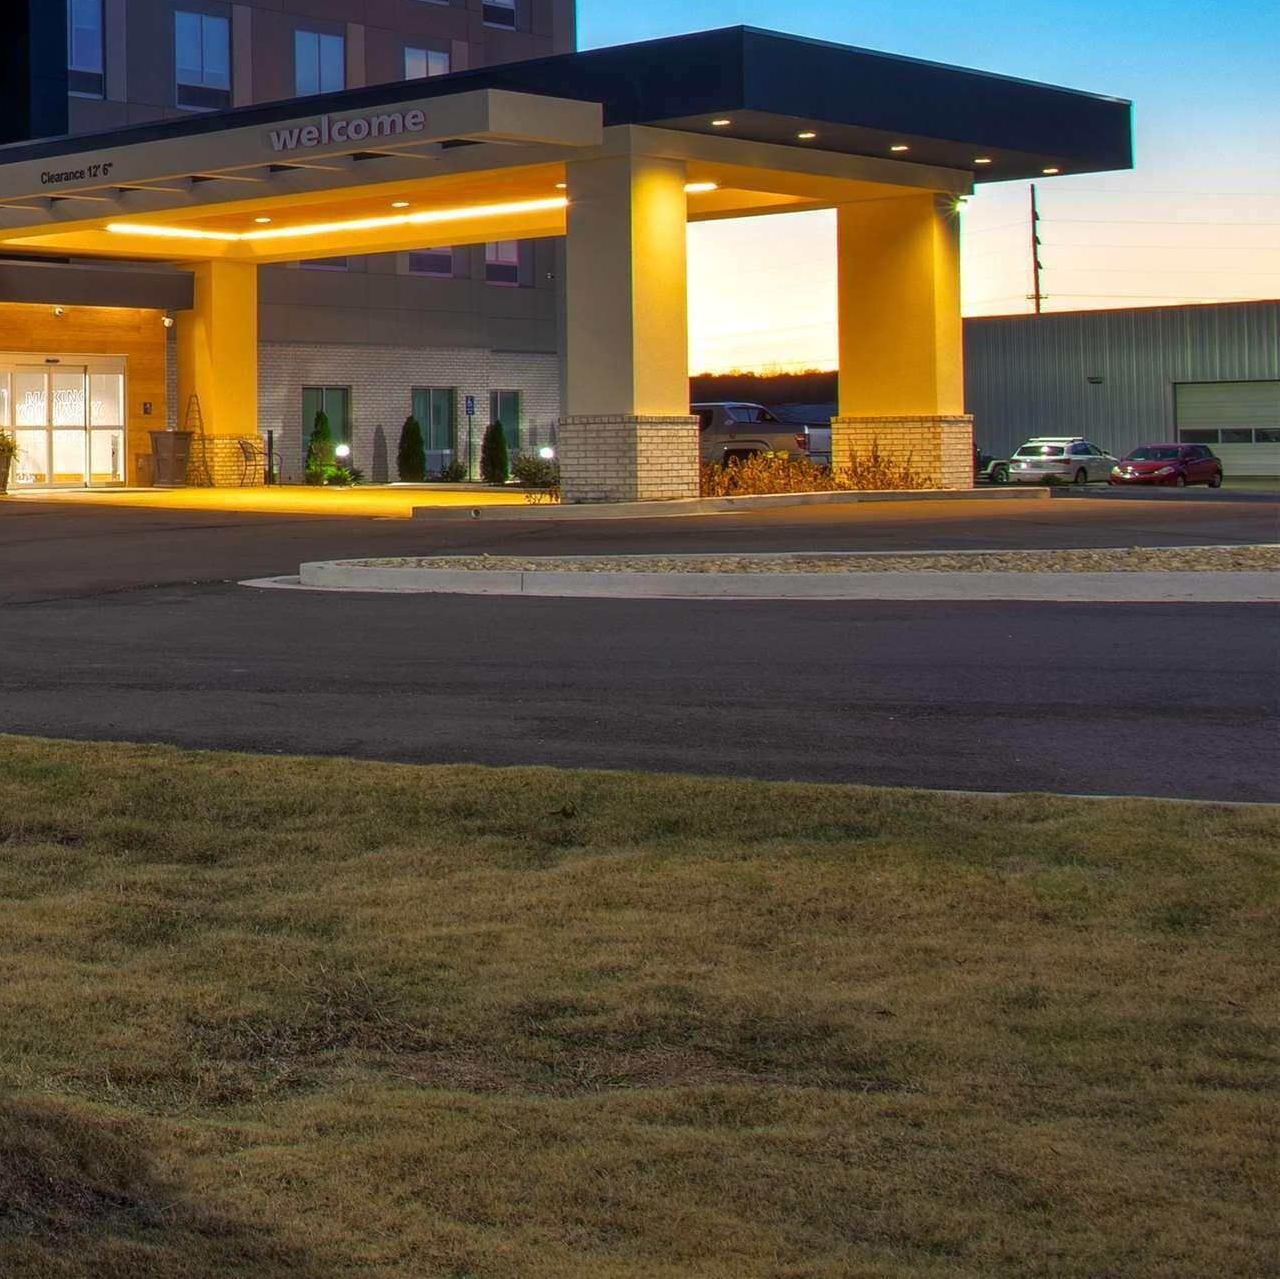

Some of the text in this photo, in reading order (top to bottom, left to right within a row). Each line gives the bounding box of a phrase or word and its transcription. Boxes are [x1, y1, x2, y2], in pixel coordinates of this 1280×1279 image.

[270, 109, 425, 151] welcome
[41, 167, 86, 184] Clearance
[87, 164, 101, 177] 12'
